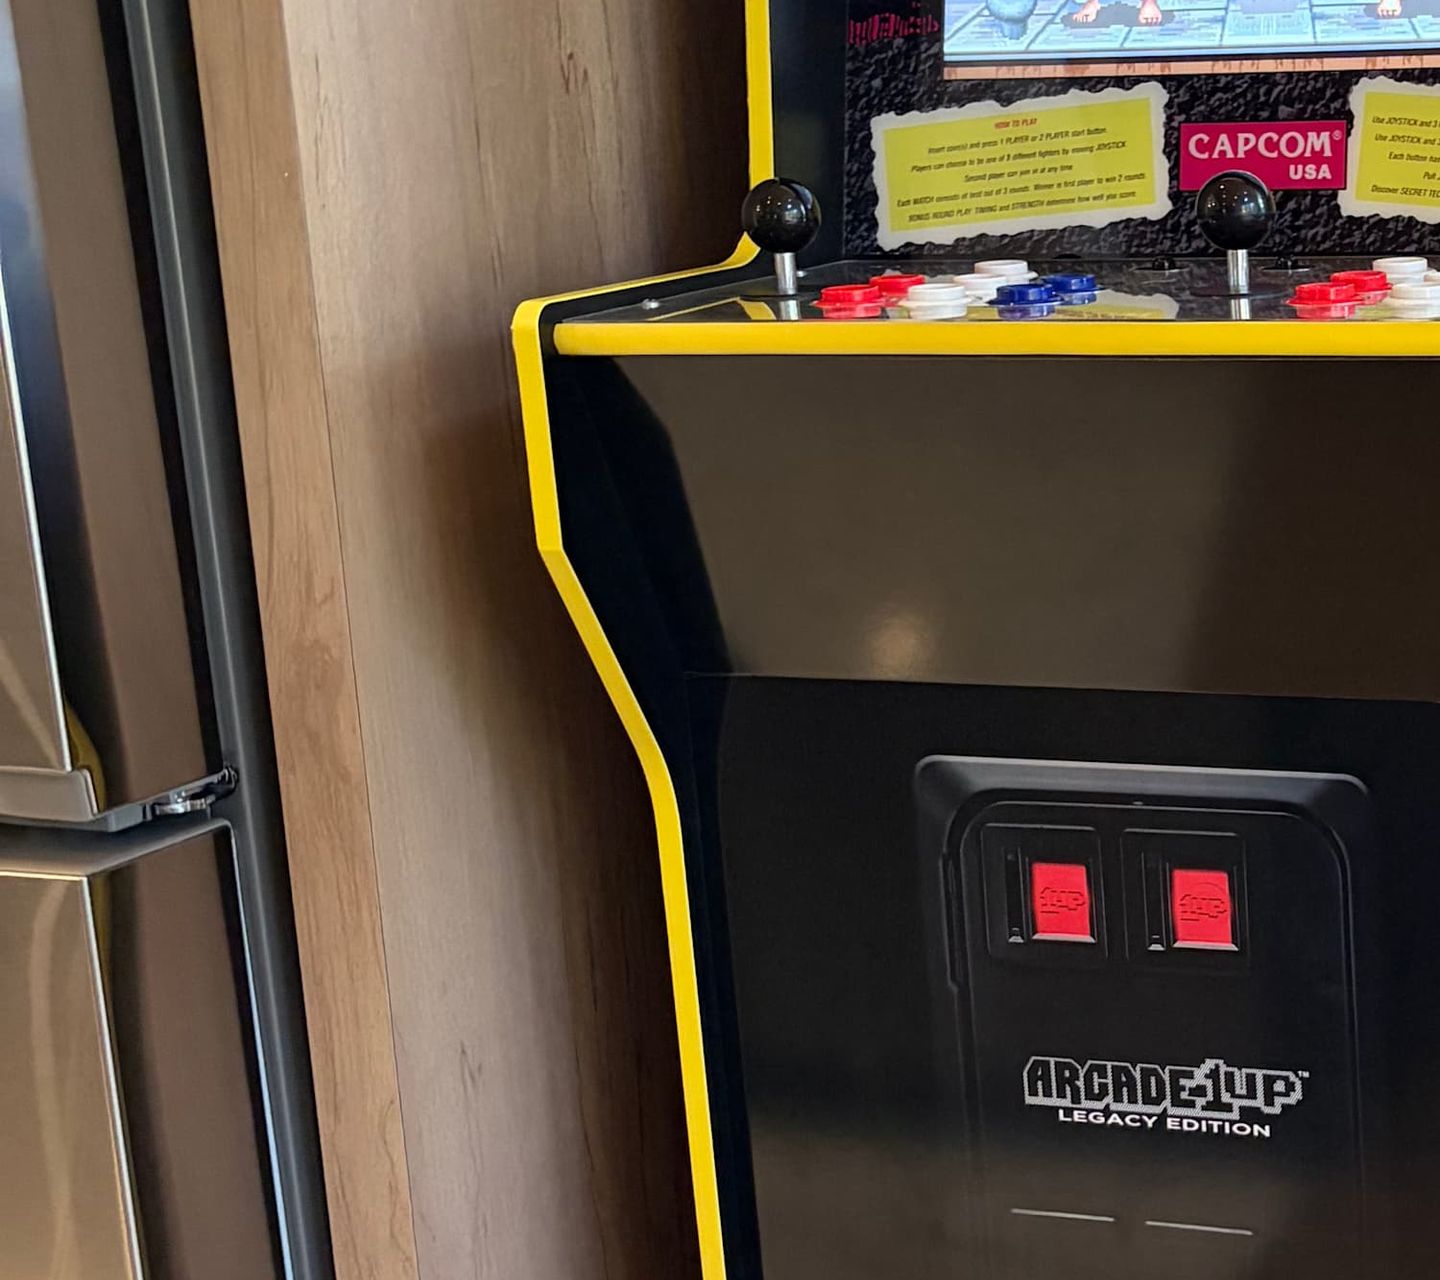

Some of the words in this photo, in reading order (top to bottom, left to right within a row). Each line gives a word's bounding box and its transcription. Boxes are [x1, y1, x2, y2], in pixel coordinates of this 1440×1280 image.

[1372, 116, 1385, 124] Use
[1386, 117, 1418, 126] JOYSTICK
[1006, 135, 1029, 144] PLAYER
[1039, 133, 1044, 141] 2
[1045, 131, 1069, 140] PLAYER
[1388, 135, 1421, 144] JOYSTICK
[1188, 131, 1333, 159] CAPCOM
[1388, 152, 1404, 160] Each
[1406, 154, 1427, 162] button
[1429, 155, 1440, 163] has
[1289, 164, 1332, 180] USA
[1423, 171, 1436, 179] Pull
[1371, 185, 1398, 194] Discover
[1400, 187, 1426, 196] SECRET
[1058, 1107, 1159, 1130] LEGACY
[1166, 1116, 1271, 1138] EDITION
